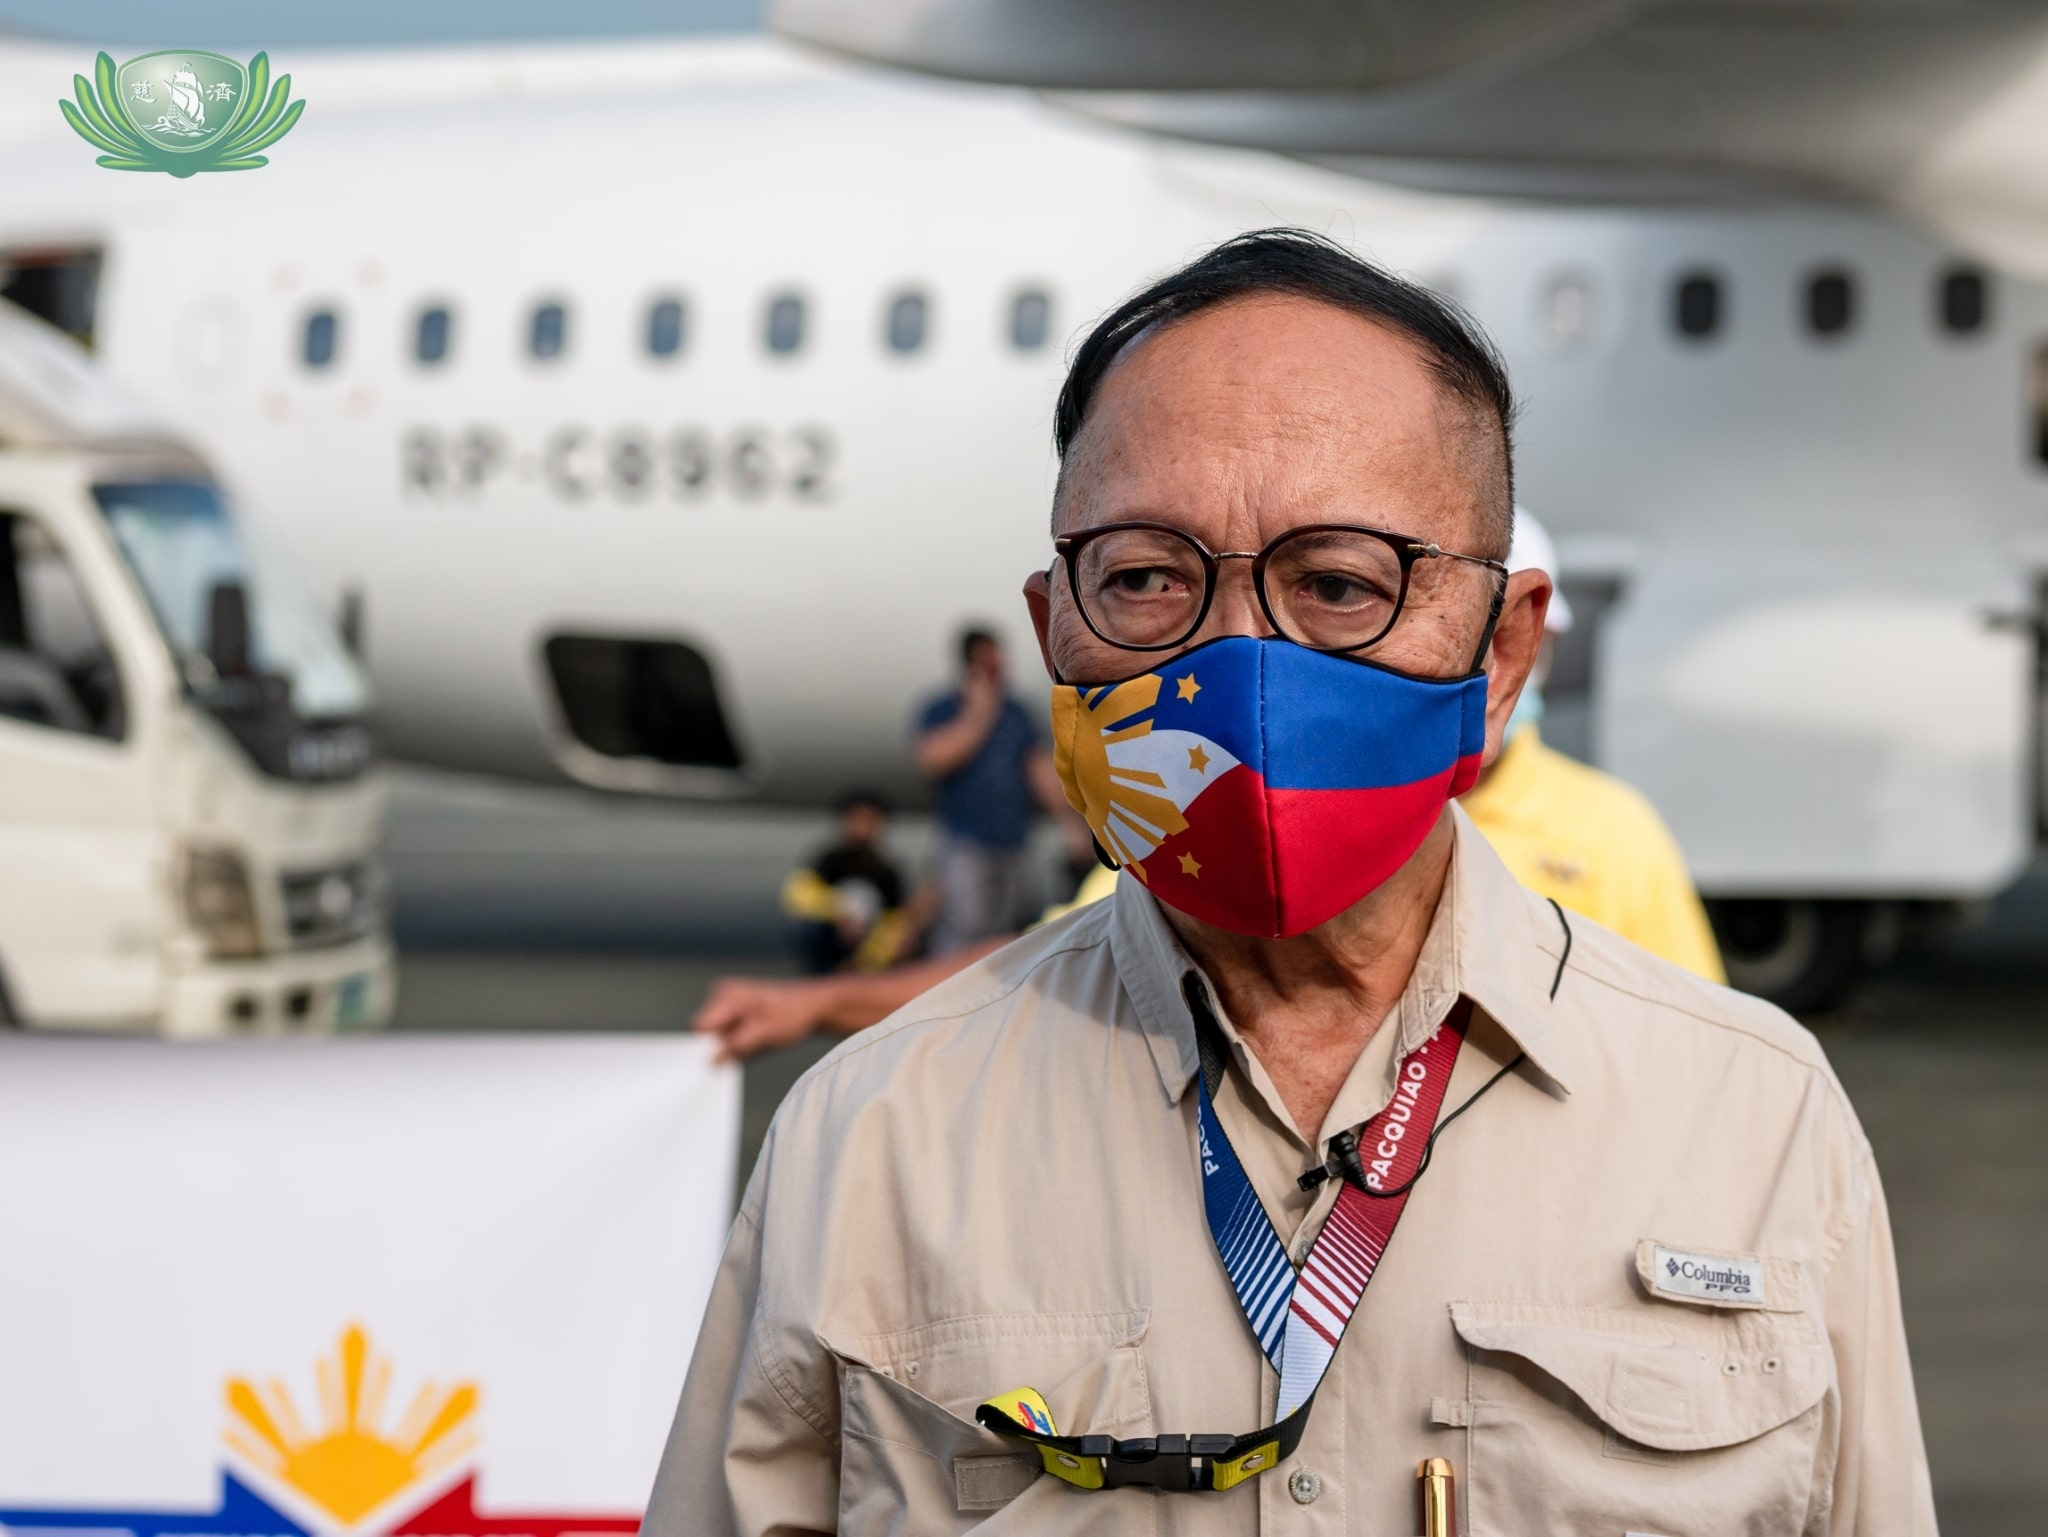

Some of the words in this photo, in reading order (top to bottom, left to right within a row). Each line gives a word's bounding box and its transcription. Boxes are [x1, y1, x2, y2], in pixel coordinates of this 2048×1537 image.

[1365, 1061, 1427, 1191] PACQUIAO
[1681, 1261, 1751, 1286] Columbia
[1704, 1282, 1751, 1294] PFG
